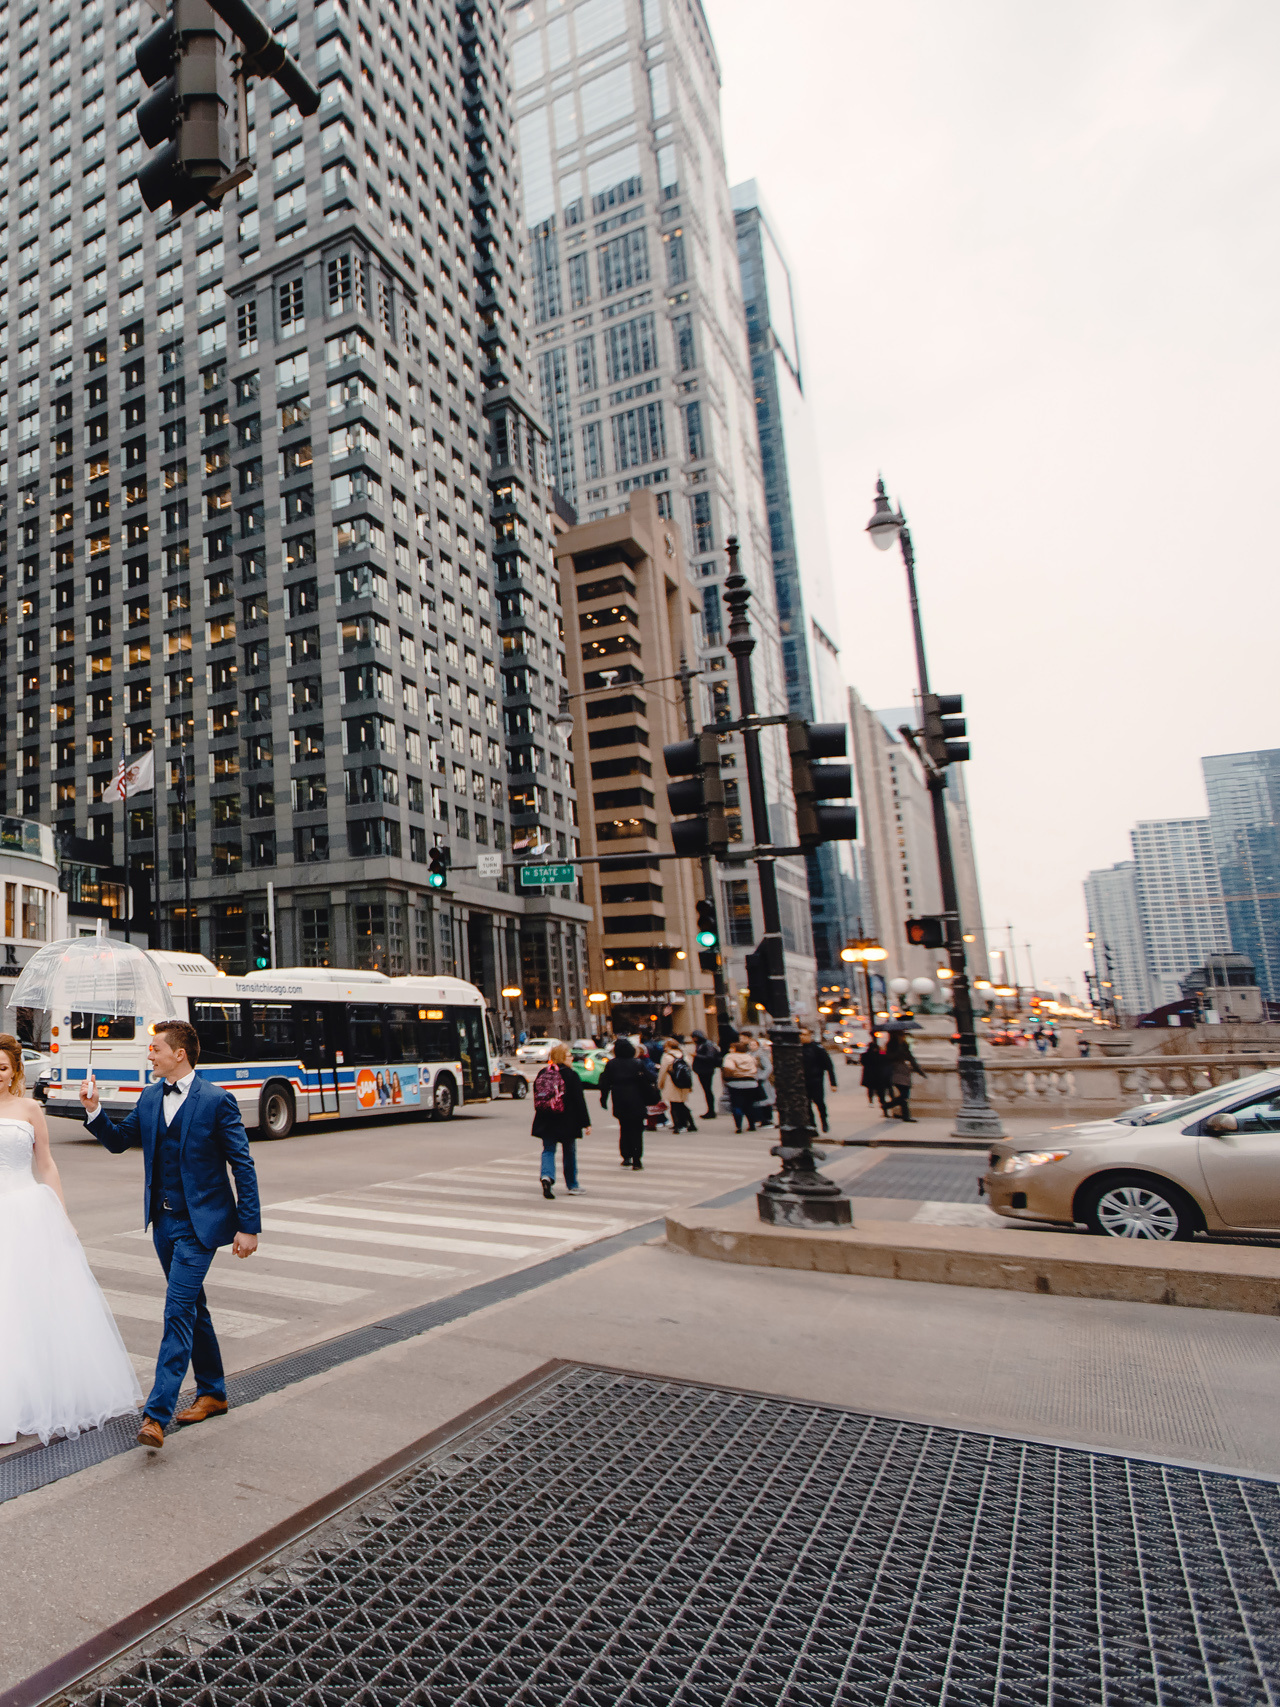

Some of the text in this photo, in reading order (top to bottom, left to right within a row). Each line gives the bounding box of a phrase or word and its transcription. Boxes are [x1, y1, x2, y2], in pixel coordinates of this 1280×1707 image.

[534, 868, 558, 876] STATE
[5, 944, 20, 964] R
[236, 982, 303, 996] transitchicago.com
[97, 1025, 109, 1037] 62
[357, 1080, 377, 1098] JAM
